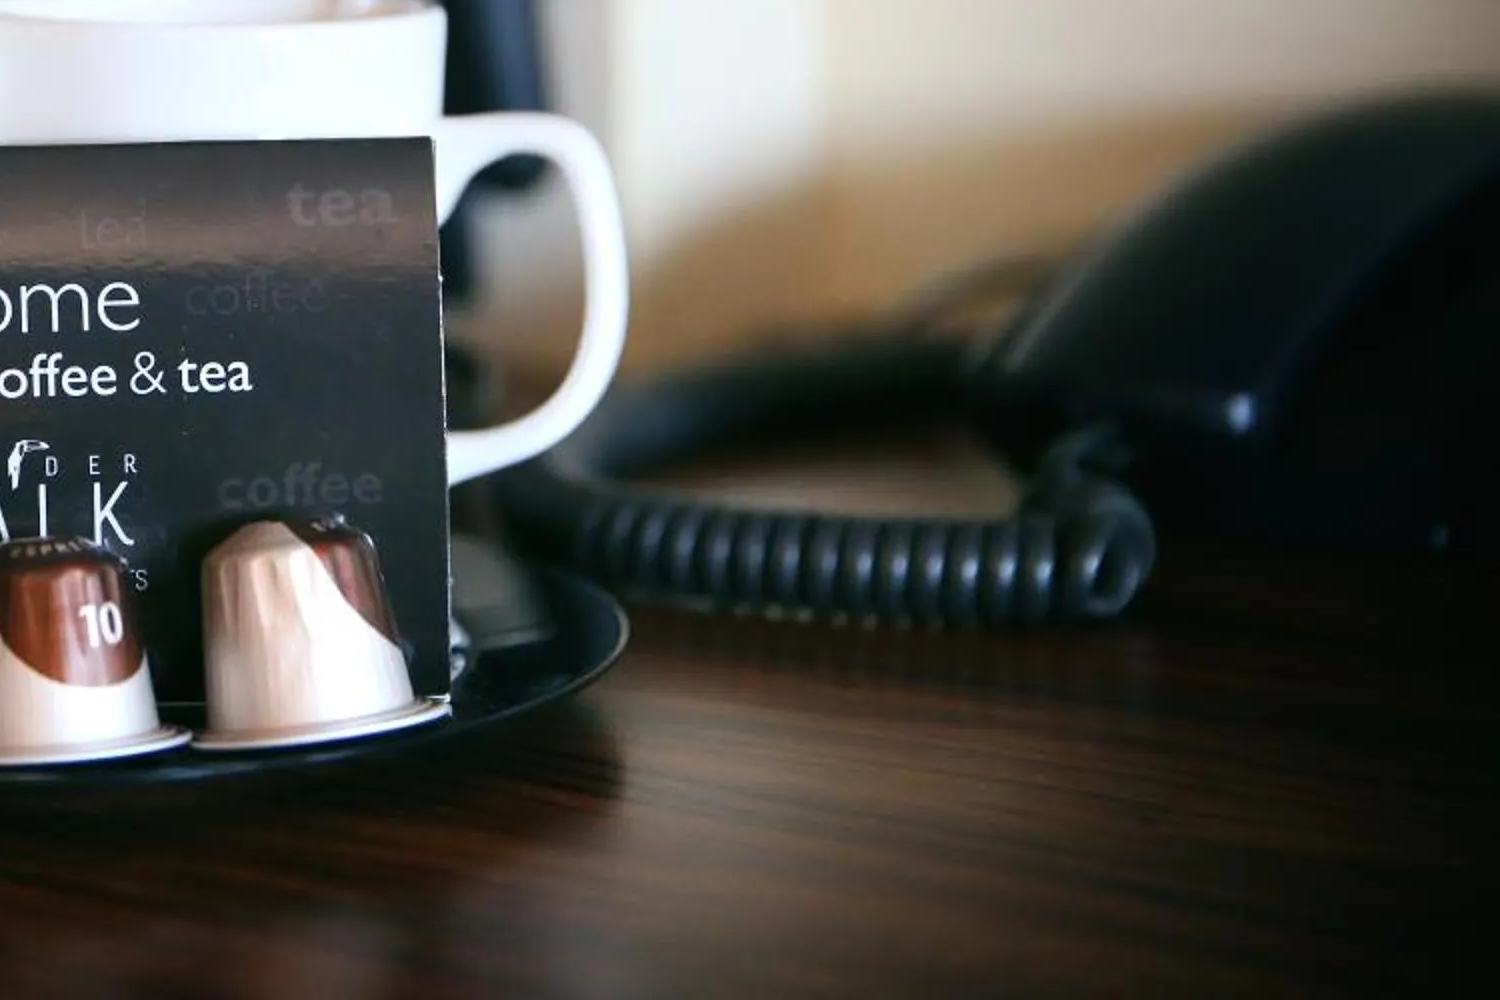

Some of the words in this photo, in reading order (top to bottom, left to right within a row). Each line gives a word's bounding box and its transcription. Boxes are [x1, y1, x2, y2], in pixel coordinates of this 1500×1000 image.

[285, 181, 401, 229] tea
[184, 267, 330, 317] coffee
[129, 351, 168, 395] &
[177, 358, 254, 394] tea
[44, 453, 138, 478] DER
[217, 461, 382, 511] coffee
[78, 601, 124, 648] 10
